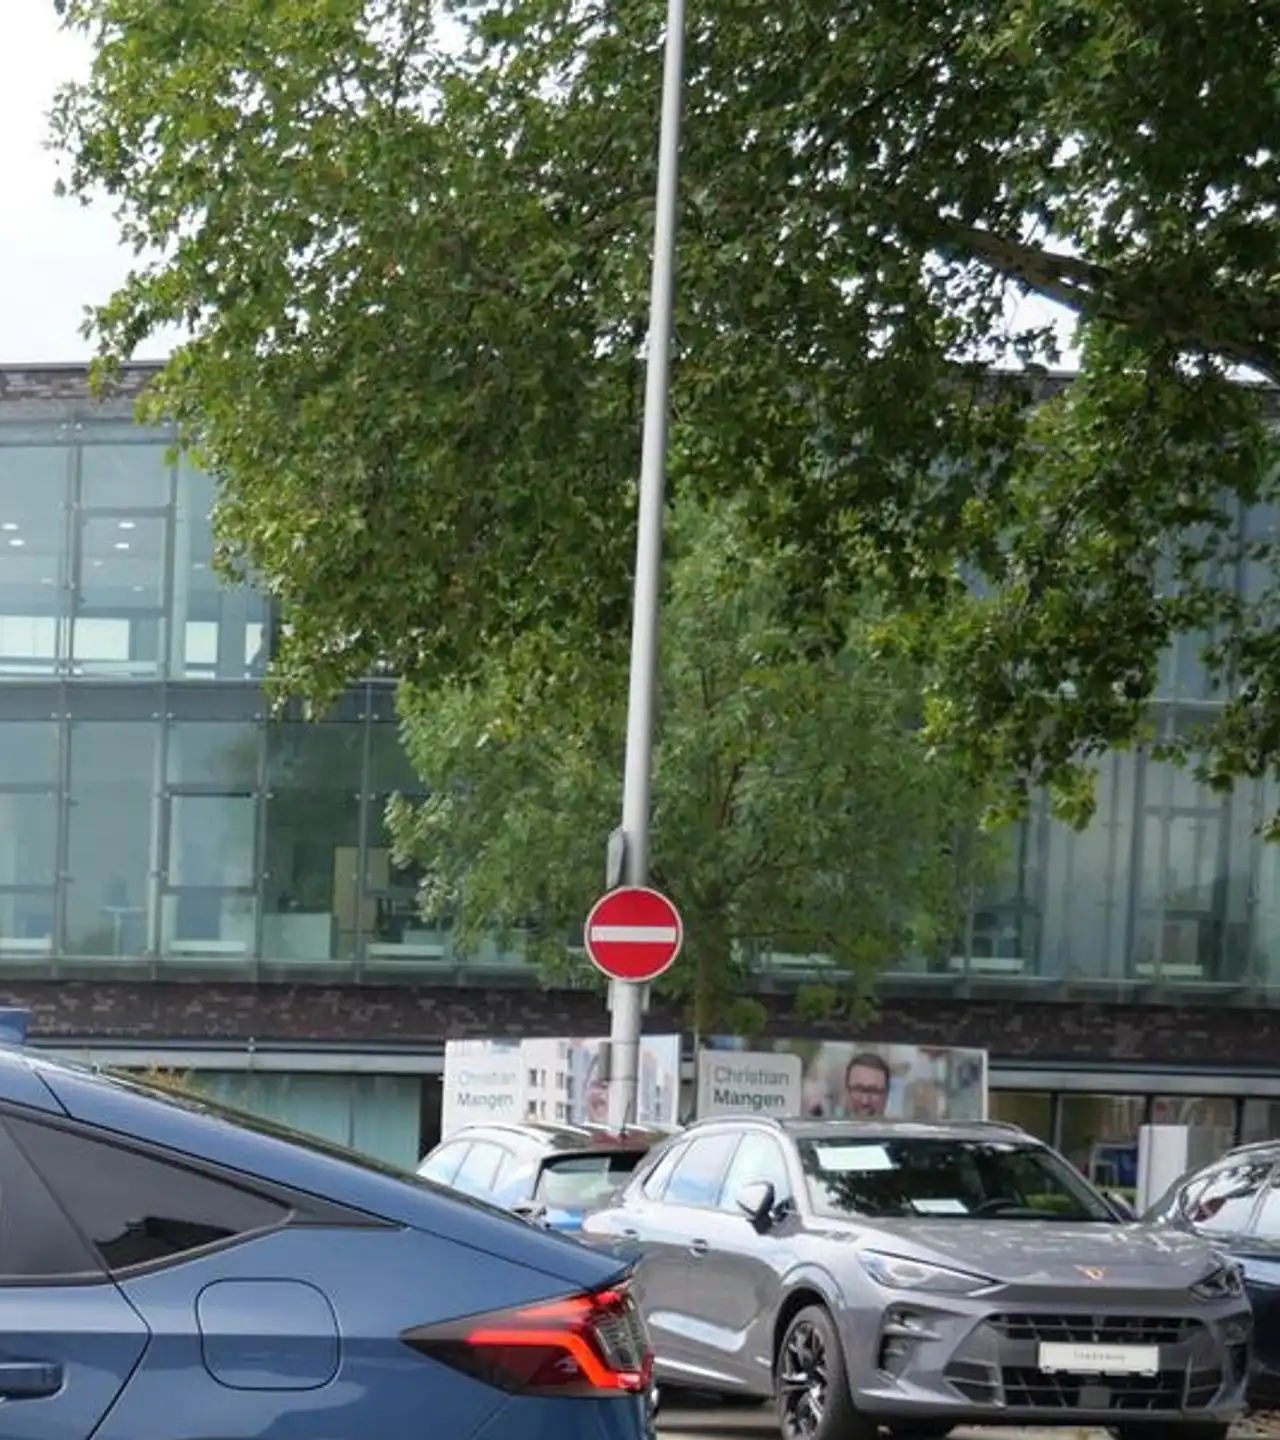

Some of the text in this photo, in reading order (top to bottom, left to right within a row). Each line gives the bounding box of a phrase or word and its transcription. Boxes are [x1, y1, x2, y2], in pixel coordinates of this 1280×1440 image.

[713, 1066, 790, 1086] Christian
[457, 1092, 514, 1111] Mangen
[713, 1088, 786, 1111] Mangen
